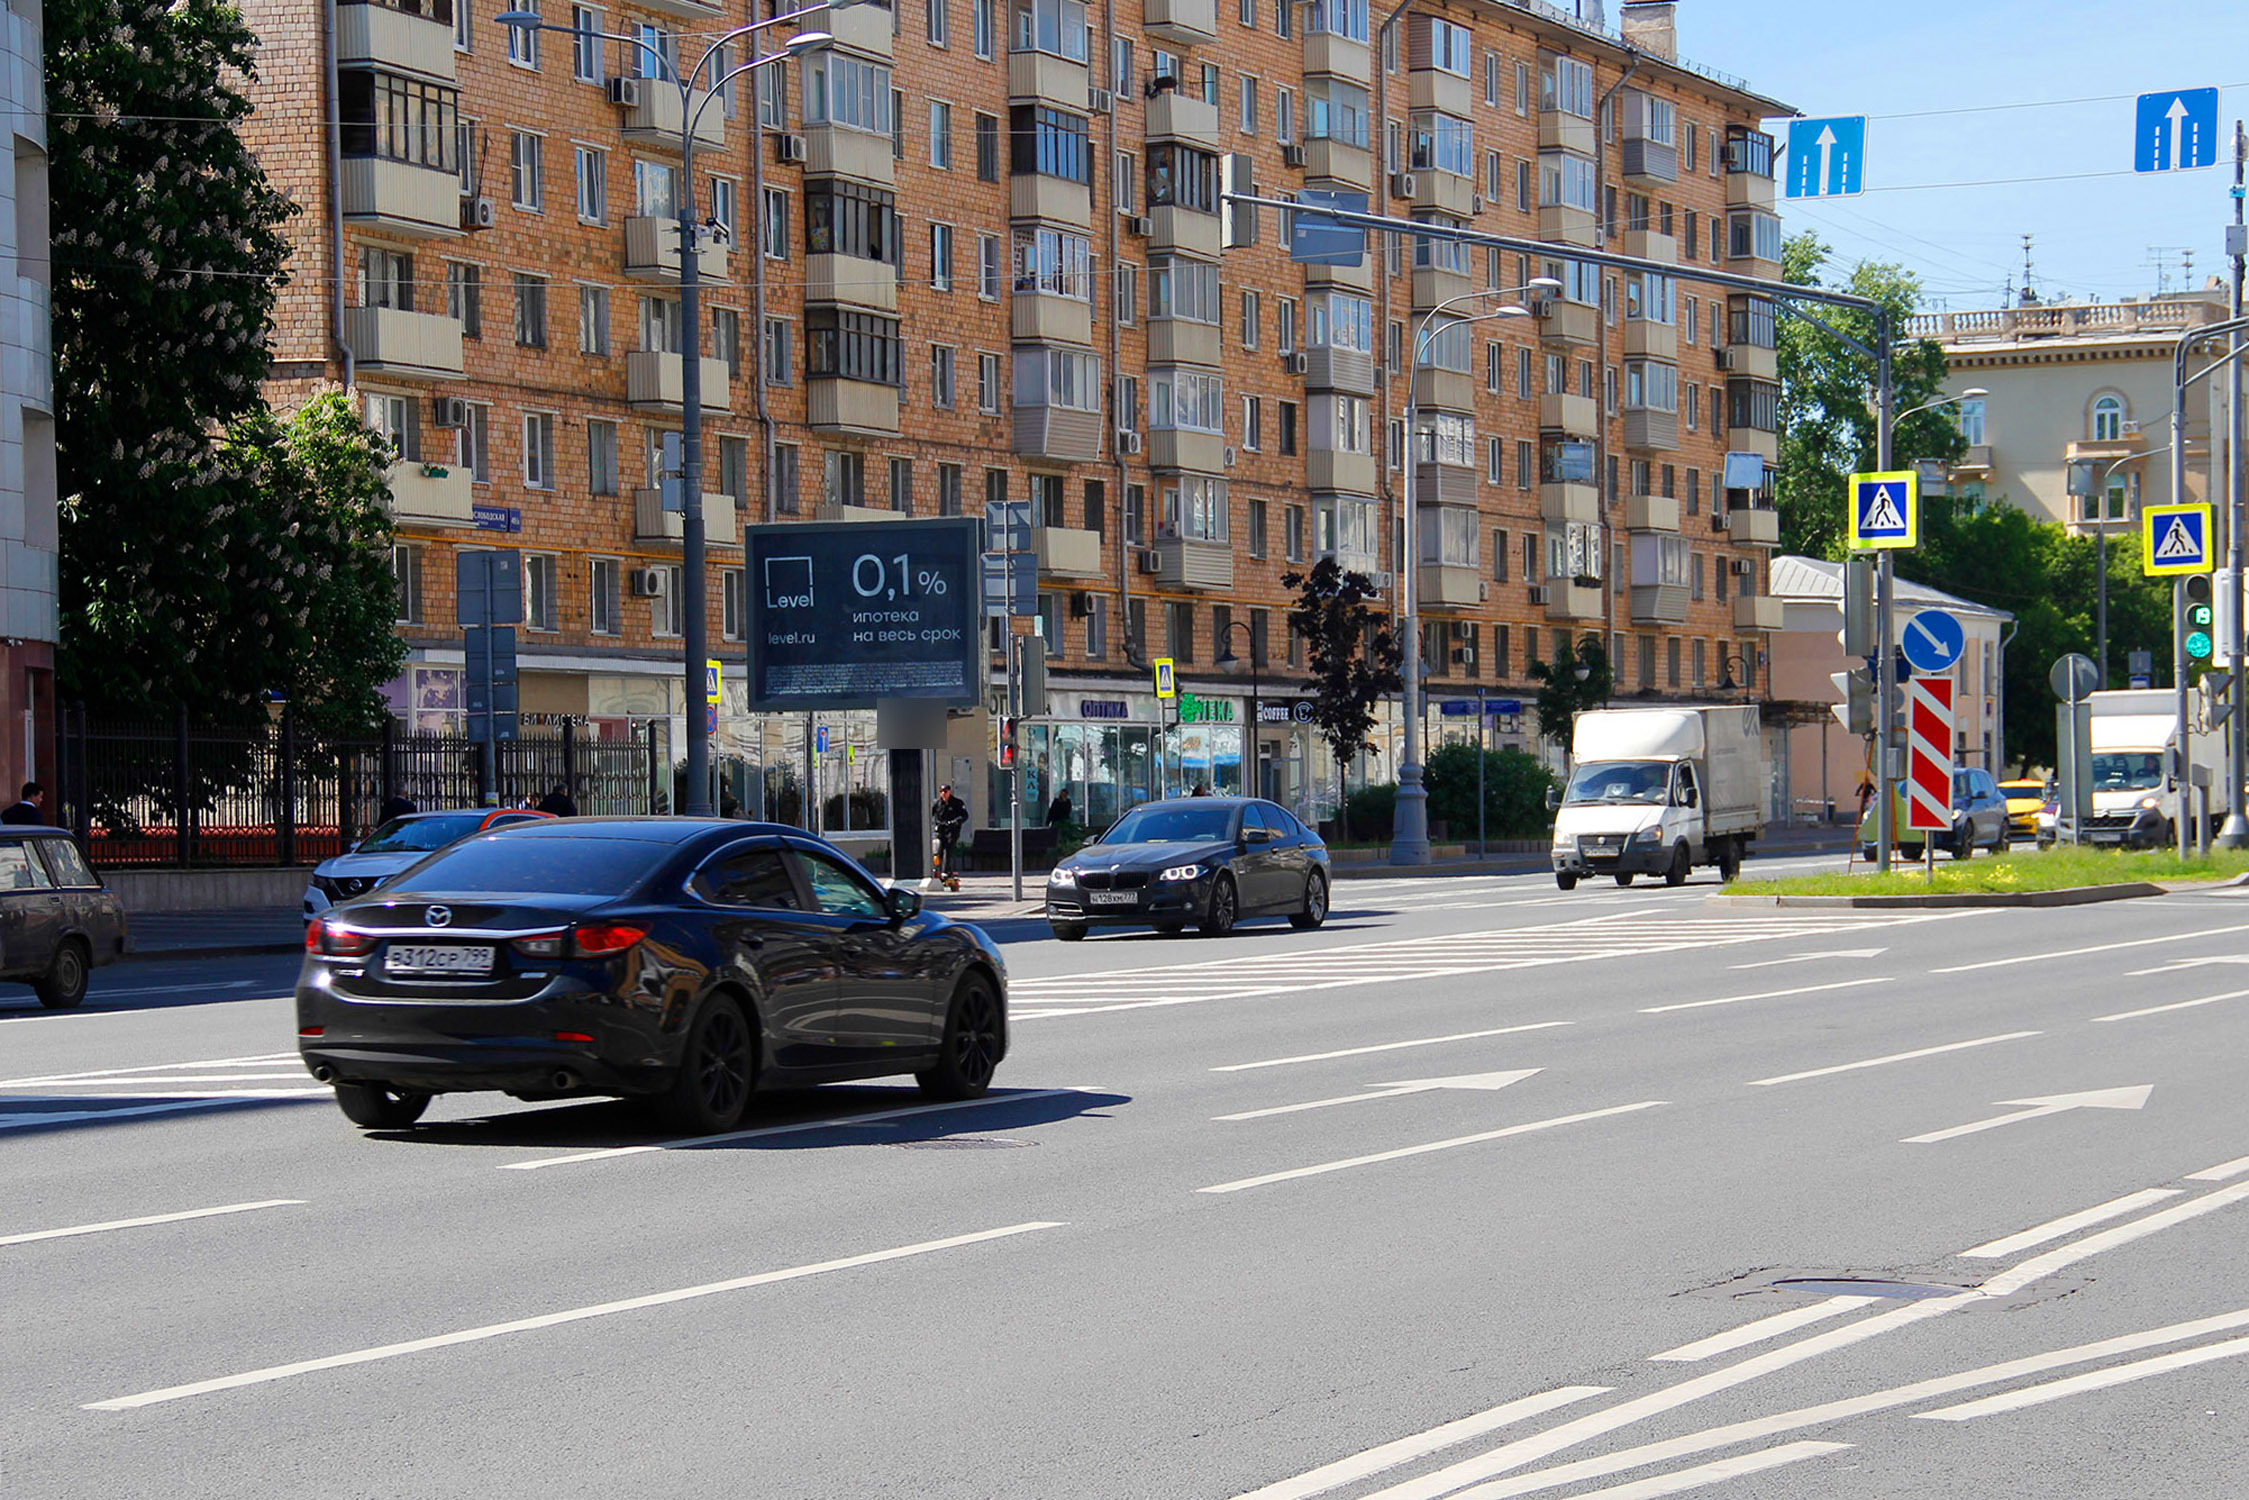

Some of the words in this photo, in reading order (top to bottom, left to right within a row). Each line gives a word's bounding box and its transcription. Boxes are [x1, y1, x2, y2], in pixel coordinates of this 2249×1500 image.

[766, 587, 814, 608] Level
[852, 610, 919, 624] ипотека
[2196, 607, 2211, 625] 19
[768, 631, 816, 645] level.ru
[853, 631, 874, 643] на
[878, 629, 917, 642] весь
[920, 627, 961, 645] срок
[1081, 700, 1128, 718] ОПТИКА
[1263, 707, 1289, 720] COFFEE
